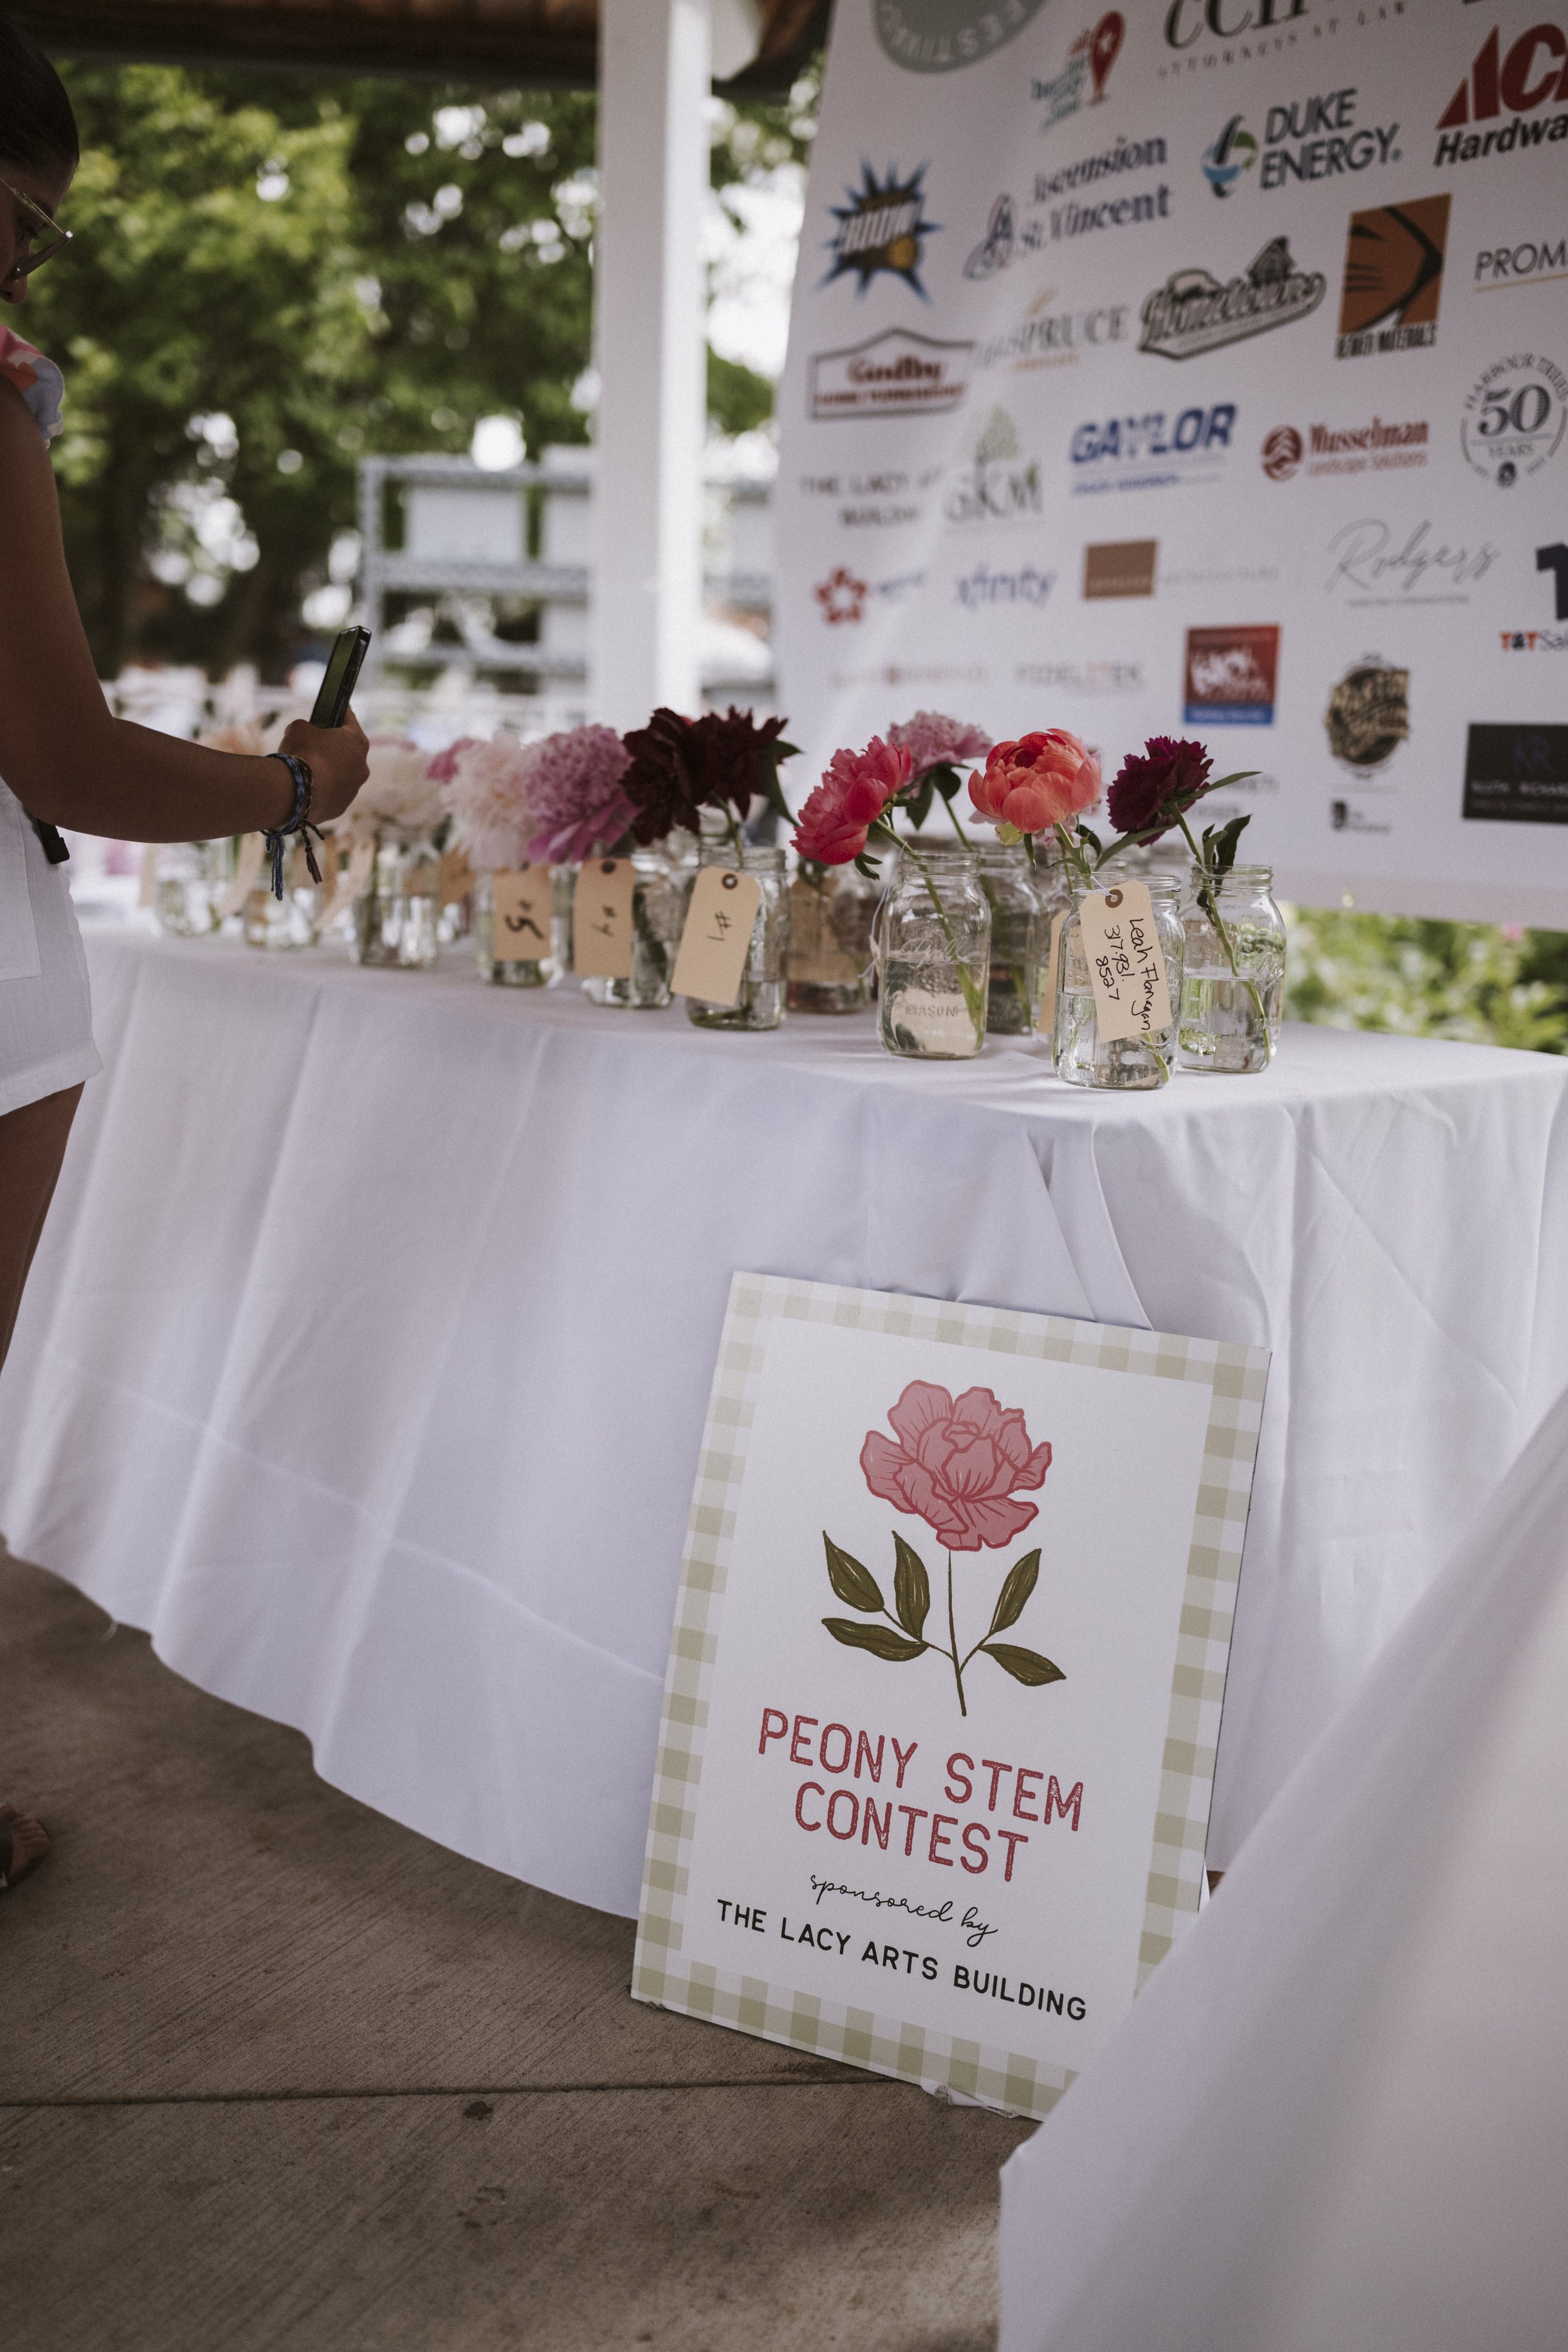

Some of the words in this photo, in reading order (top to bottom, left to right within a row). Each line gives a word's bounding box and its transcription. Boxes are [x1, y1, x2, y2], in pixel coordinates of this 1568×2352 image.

[1264, 87, 1357, 145] DUKE
[1259, 122, 1400, 190] ENERGY
[1070, 402, 1237, 465] GAYLOR
[1477, 383, 1551, 438] 50
[706, 909, 732, 942] #1
[1128, 918, 1153, 963] Leah
[1095, 955, 1120, 1001] 8527
[1130, 962, 1160, 1030] Flanagan
[758, 1707, 918, 1789] PEONY
[943, 1752, 1084, 1832] STEM
[795, 1781, 1029, 1882] CONTEST
[810, 1874, 953, 1922] sponsored
[961, 1907, 999, 1947] by
[717, 1899, 767, 1933] THE
[780, 1917, 851, 1956] LACY
[861, 1941, 938, 1980] ARTS
[953, 1964, 1086, 2021] BUILDING
